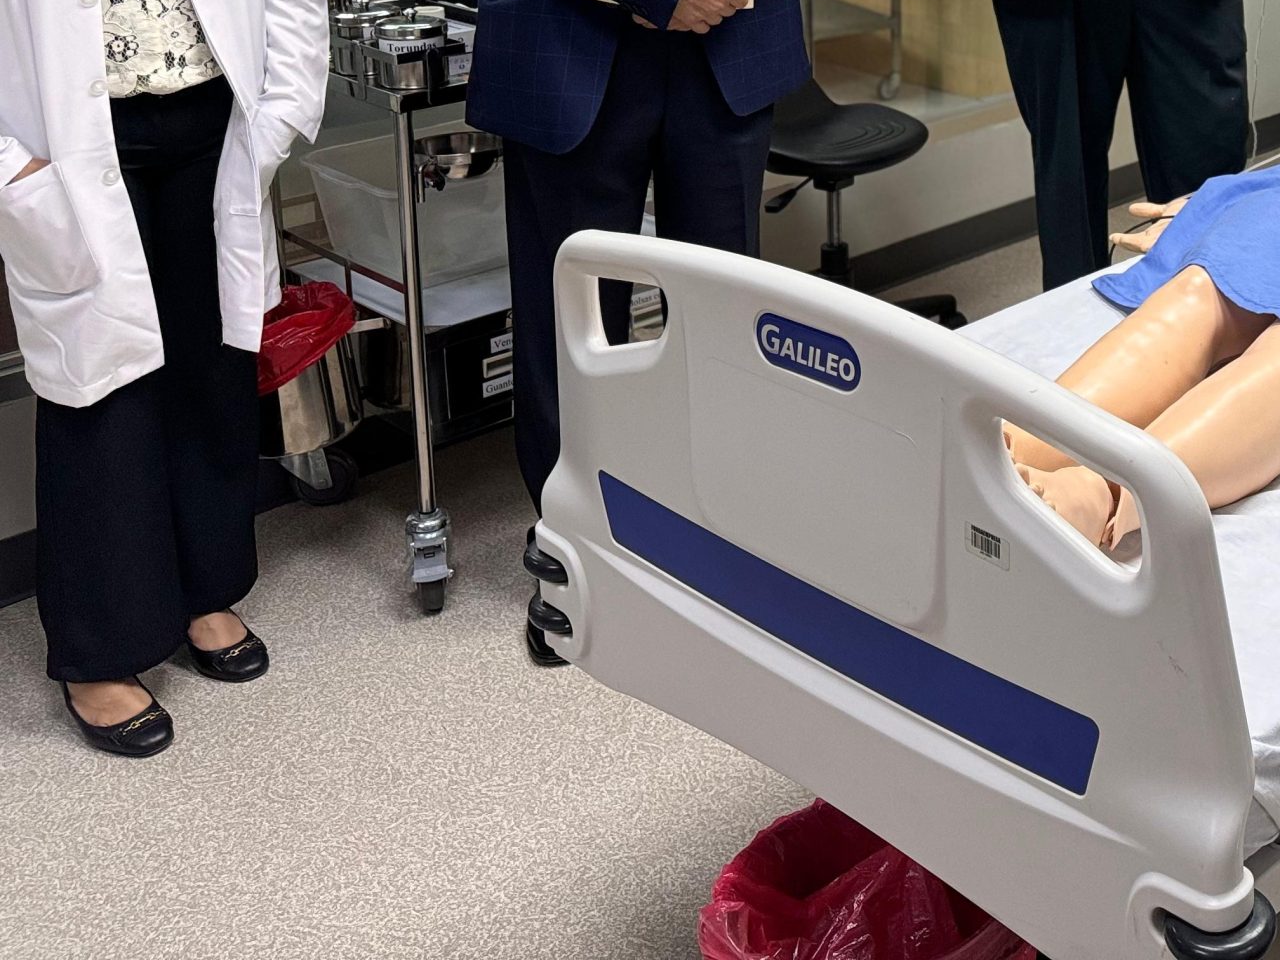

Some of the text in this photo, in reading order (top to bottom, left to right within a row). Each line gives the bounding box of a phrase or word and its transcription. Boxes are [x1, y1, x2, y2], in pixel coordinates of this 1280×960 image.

[494, 339, 511, 348] Ven
[761, 324, 855, 381] GALILEO
[486, 379, 513, 394] Guant
